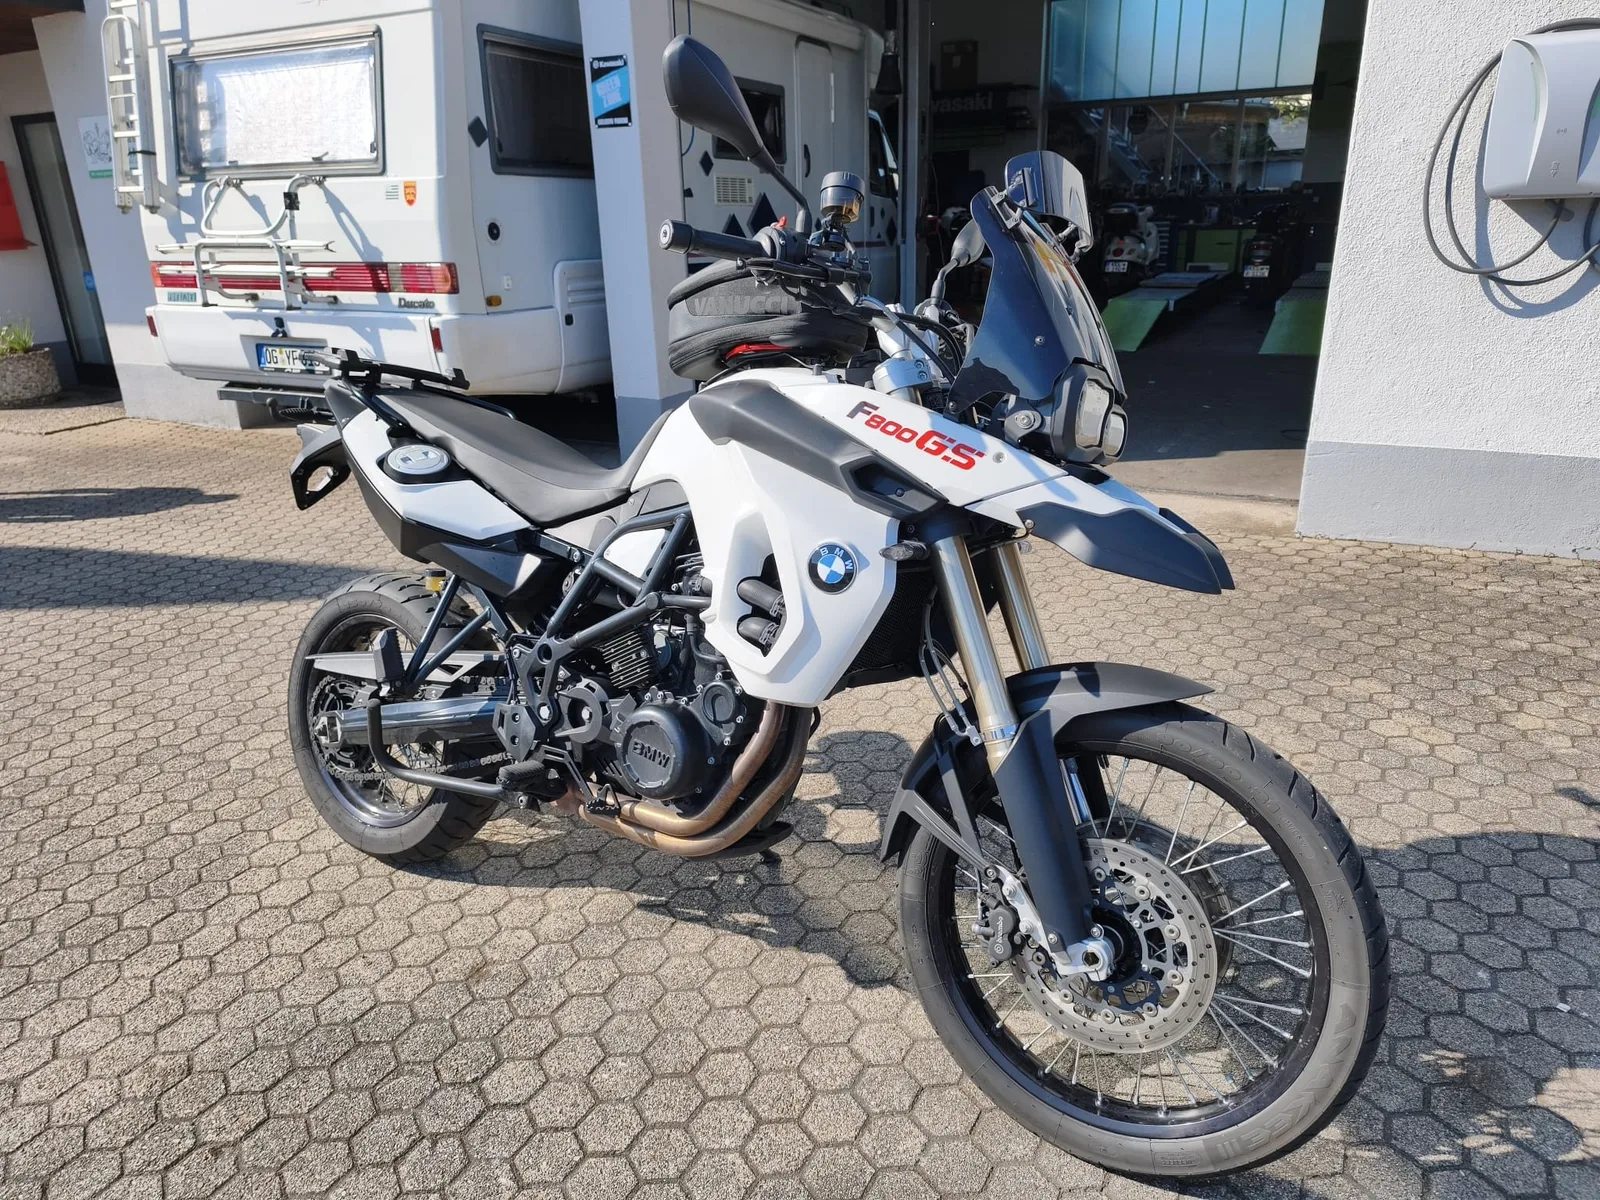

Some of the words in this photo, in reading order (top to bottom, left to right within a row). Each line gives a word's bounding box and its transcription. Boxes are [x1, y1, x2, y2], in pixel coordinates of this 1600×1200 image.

[398, 297, 436, 309] Ducato
[694, 295, 788, 316] VANUCCI
[265, 348, 279, 364] OG
[819, 546, 855, 571] BMW
[632, 739, 670, 769] BMW
[1240, 1001, 1357, 1150] ANAKEE
